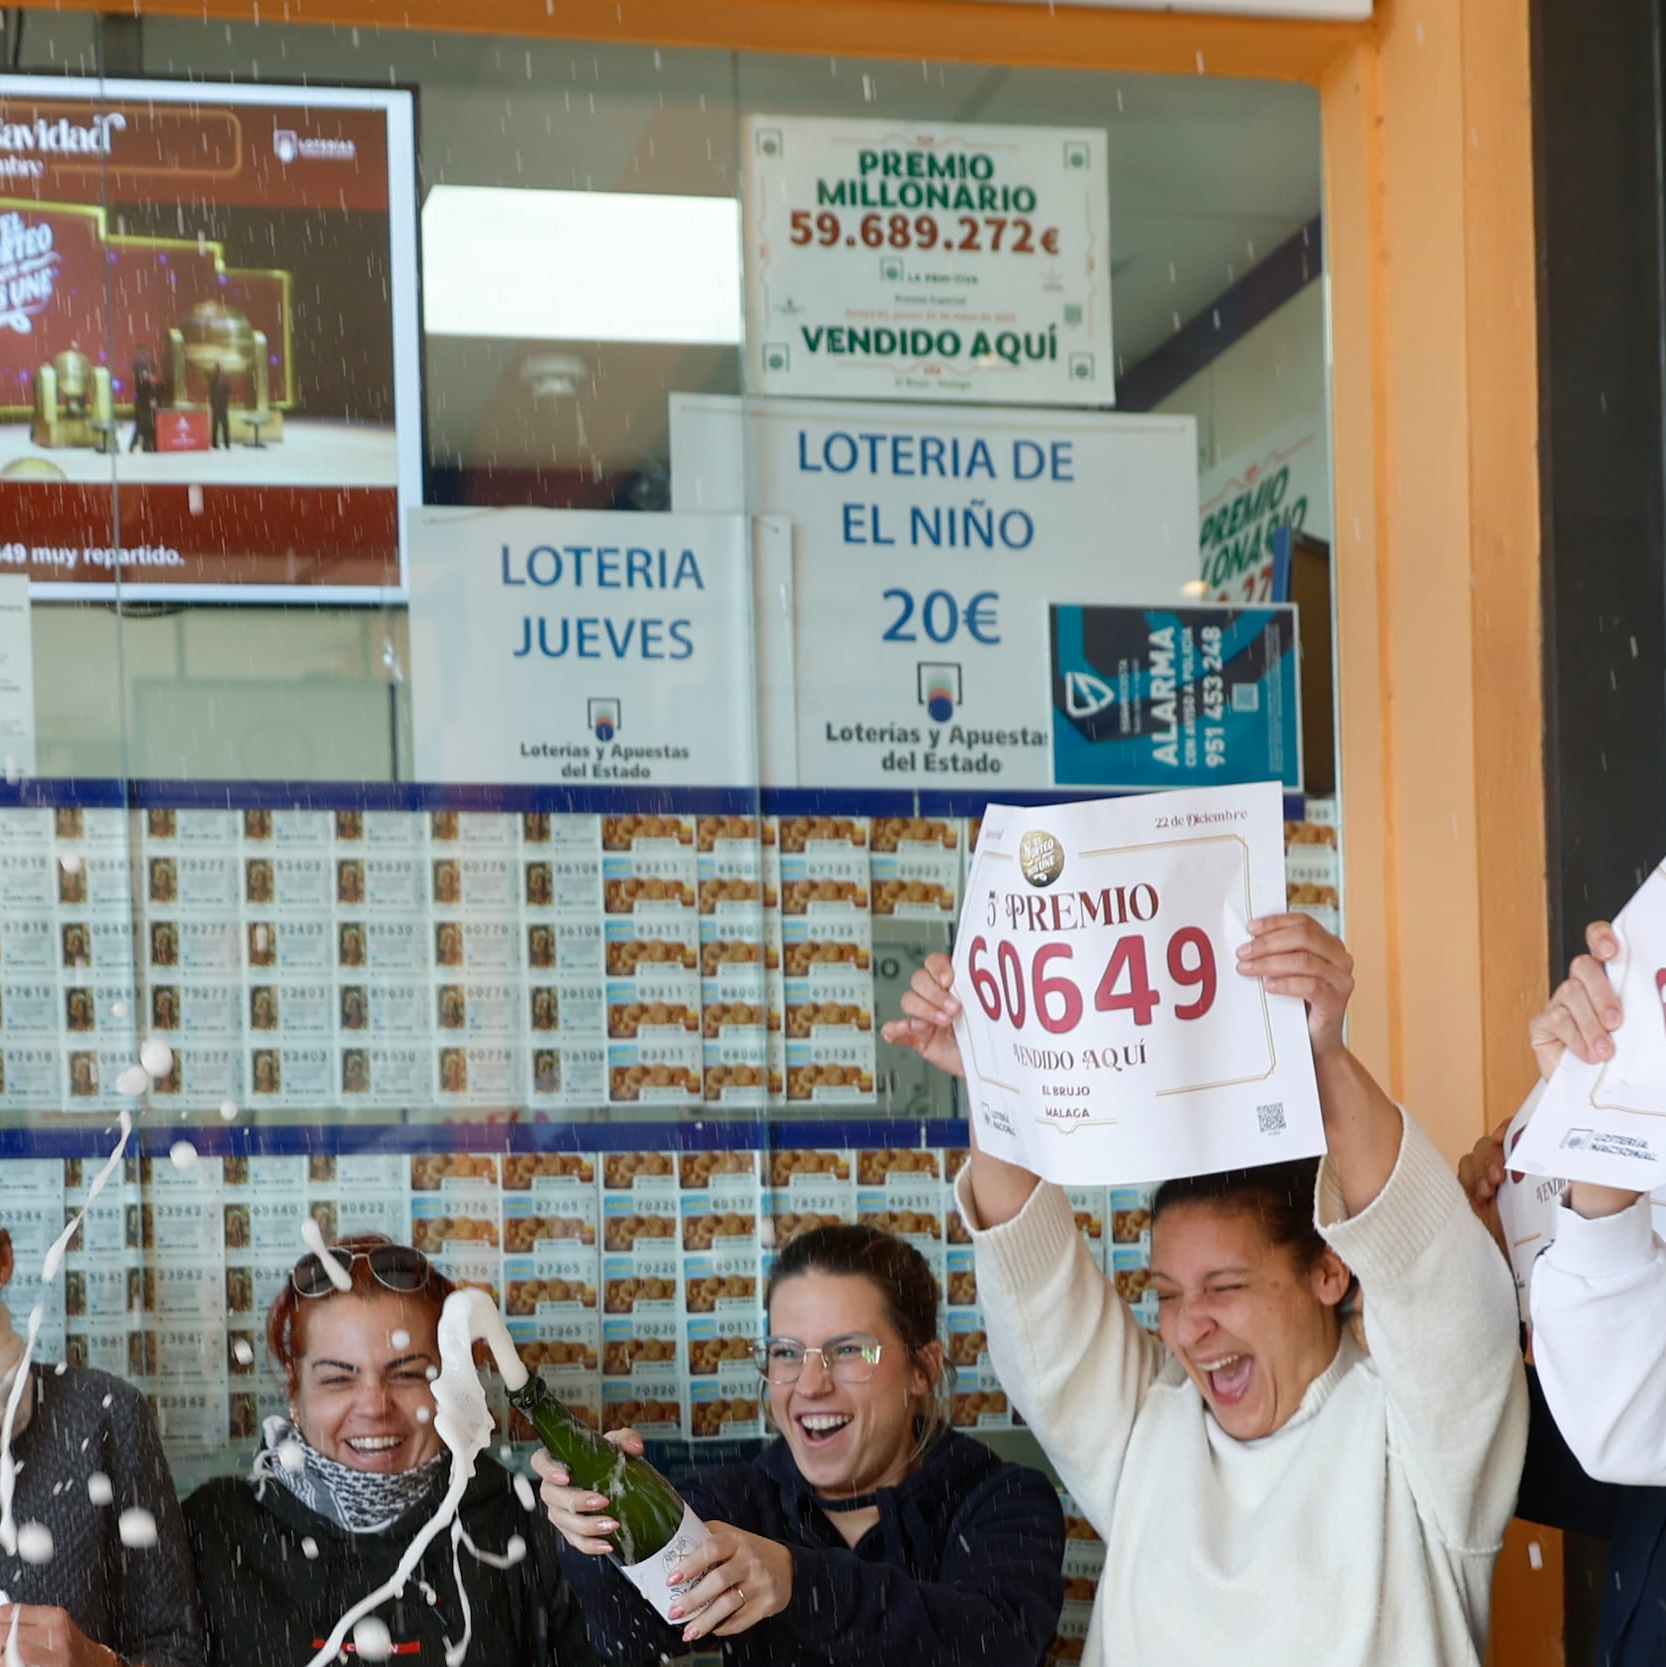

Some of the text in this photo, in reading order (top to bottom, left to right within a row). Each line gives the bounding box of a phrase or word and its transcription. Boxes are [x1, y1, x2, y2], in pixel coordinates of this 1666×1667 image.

[858, 149, 995, 181] PREMIO
[817, 178, 1037, 214] MILLONARIO
[801, 323, 1057, 365] VENDIDO AQUÍ
[798, 431, 1075, 482] LOTERIA DE
[843, 498, 1035, 550] EL NIÑO
[1201, 466, 1289, 549] PREMIO
[32, 547, 77, 568] muy
[83, 545, 186, 569] repartido.
[501, 544, 705, 590] LOTERIA
[881, 588, 1002, 646] 20€
[512, 616, 694, 660] JUEVES
[1148, 625, 1180, 767] ALARMA
[1183, 683, 1195, 692] A
[1201, 625, 1226, 767] 951 453 248
[1184, 695, 1197, 736] AVISO
[596, 747, 605, 761] y
[611, 744, 690, 760] Apuestas
[928, 728, 941, 750] y
[1185, 739, 1198, 768] CON
[561, 763, 651, 779] del Estado
[881, 751, 1002, 774] del Estado
[1155, 817, 1169, 829] 22
[1170, 815, 1184, 827] de
[1006, 883, 1160, 931] PREMIO
[969, 926, 1218, 1034] 60649
[1013, 1039, 1147, 1072] VENDIDO AQUÍ
[1053, 1086, 1091, 1096] BRUJO
[1046, 1107, 1091, 1118] MALAGA
